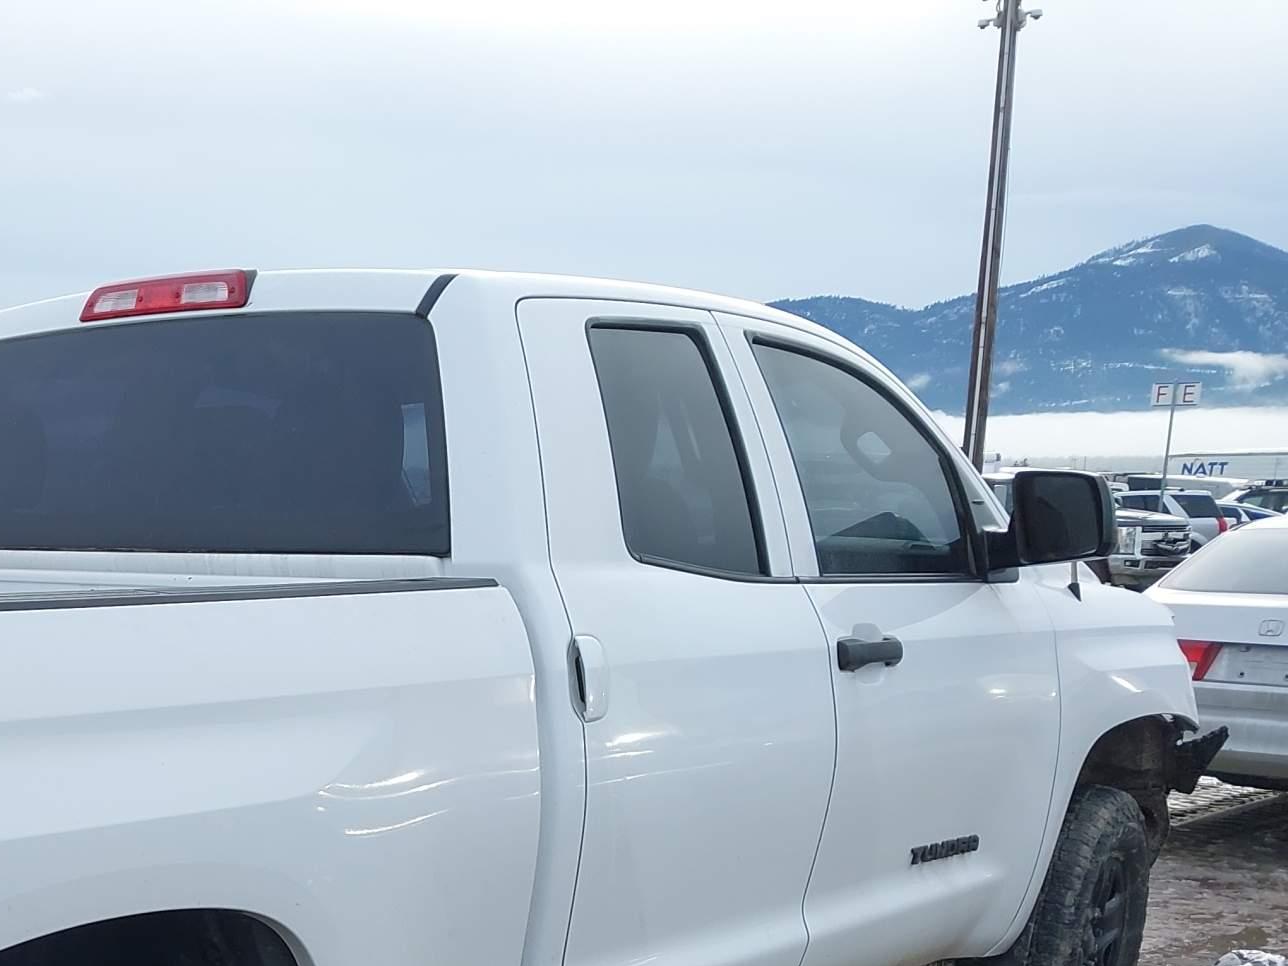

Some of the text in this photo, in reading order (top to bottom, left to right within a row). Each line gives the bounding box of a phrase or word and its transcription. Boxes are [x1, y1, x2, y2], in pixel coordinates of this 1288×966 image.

[1155, 384, 1196, 403] F E
[1181, 461, 1229, 476] NATT
[910, 834, 980, 865] TUNDRA
